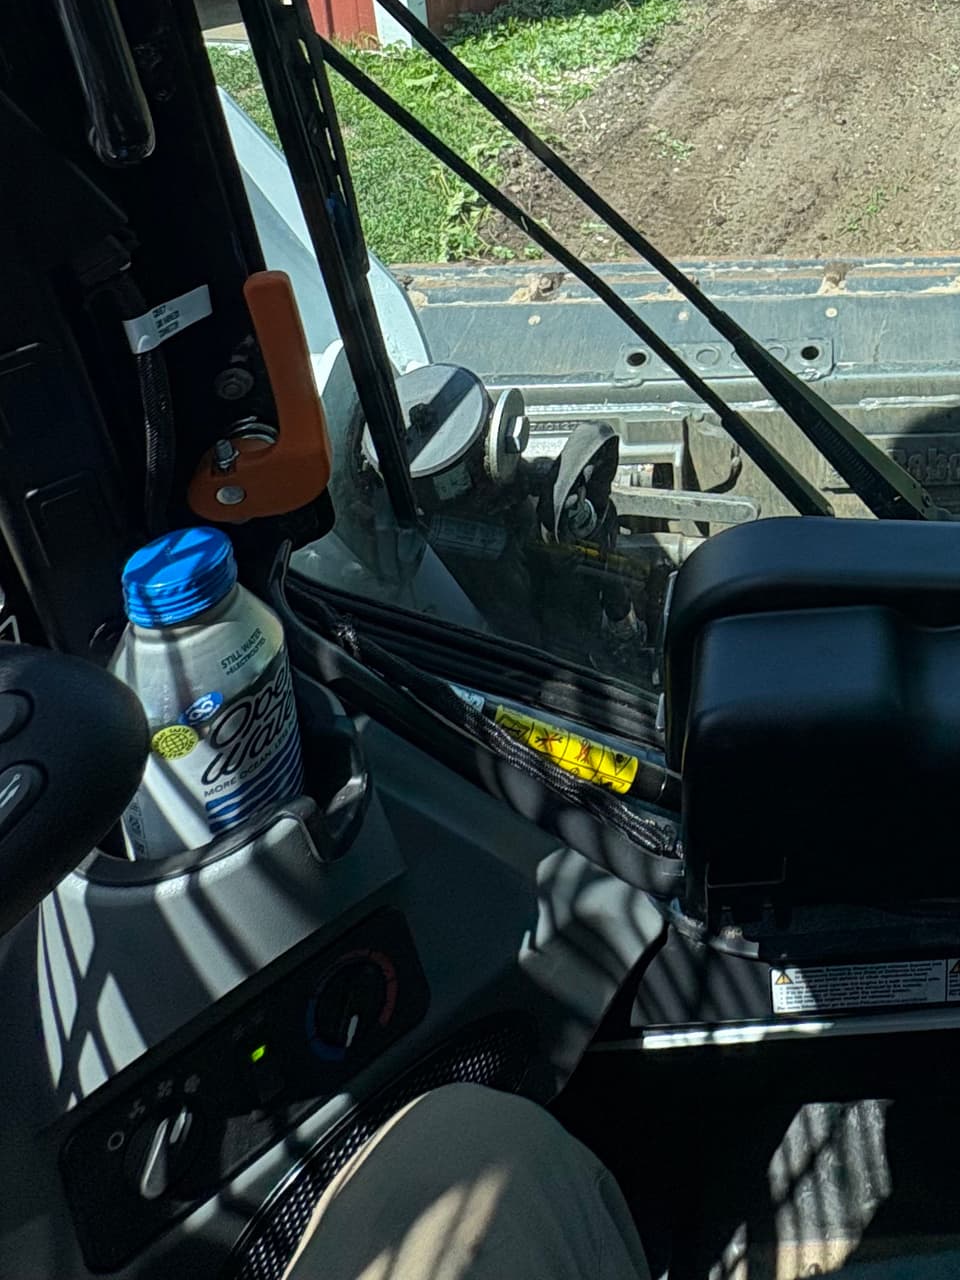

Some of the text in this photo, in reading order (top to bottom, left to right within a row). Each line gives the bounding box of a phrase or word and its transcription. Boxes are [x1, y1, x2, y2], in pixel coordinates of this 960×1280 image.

[220, 627, 263, 670] STILL WATER
[204, 778, 238, 798] MORE
[239, 751, 273, 779] OCEAN
